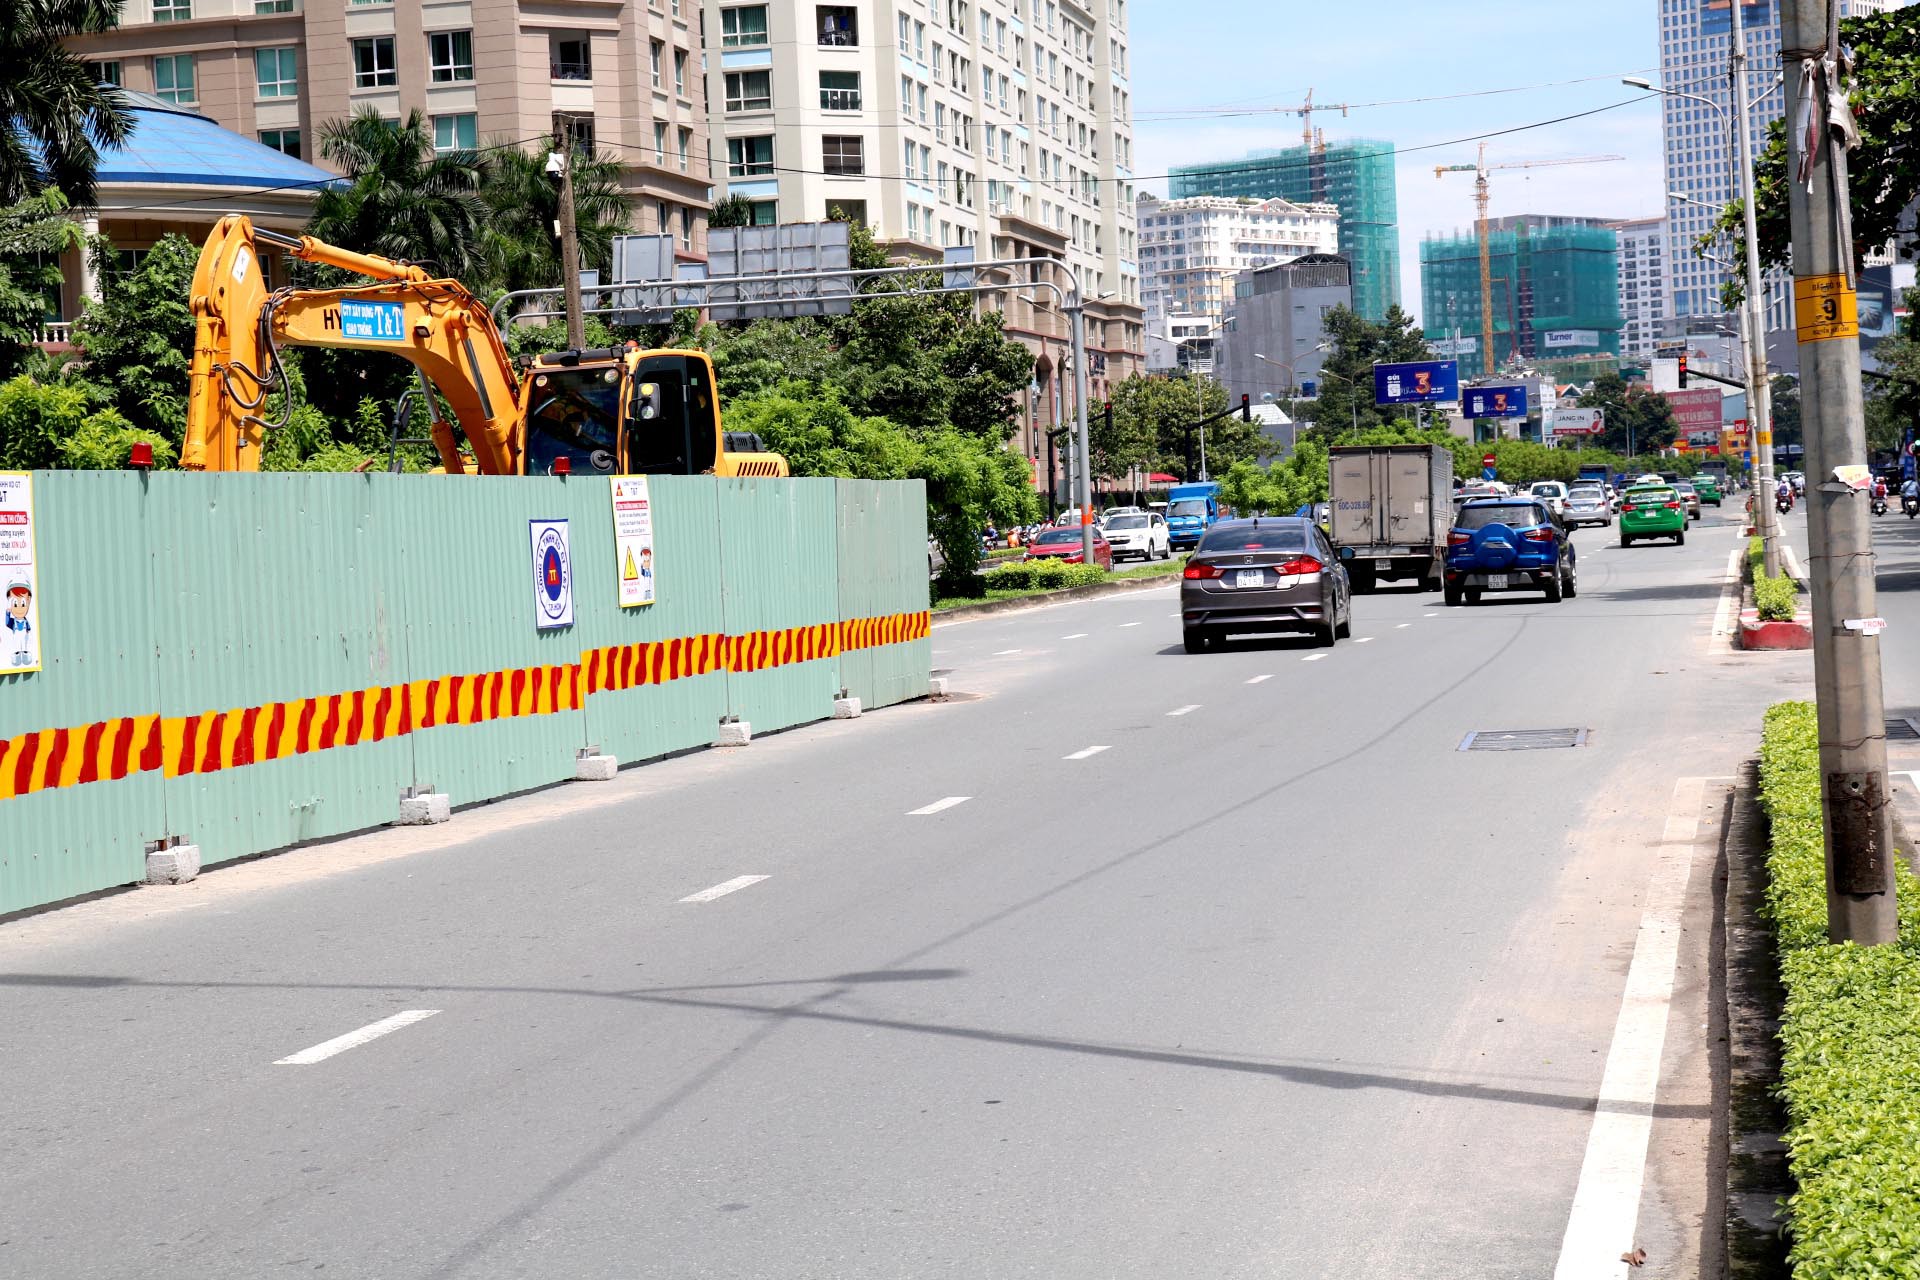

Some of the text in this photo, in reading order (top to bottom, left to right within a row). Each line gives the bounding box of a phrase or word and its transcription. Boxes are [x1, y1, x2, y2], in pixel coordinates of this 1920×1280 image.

[374, 305, 402, 336] T&T
[1823, 298, 1837, 321] 9
[1546, 333, 1573, 341] Turner
[1415, 371, 1431, 394] 3
[1494, 394, 1507, 411] 3
